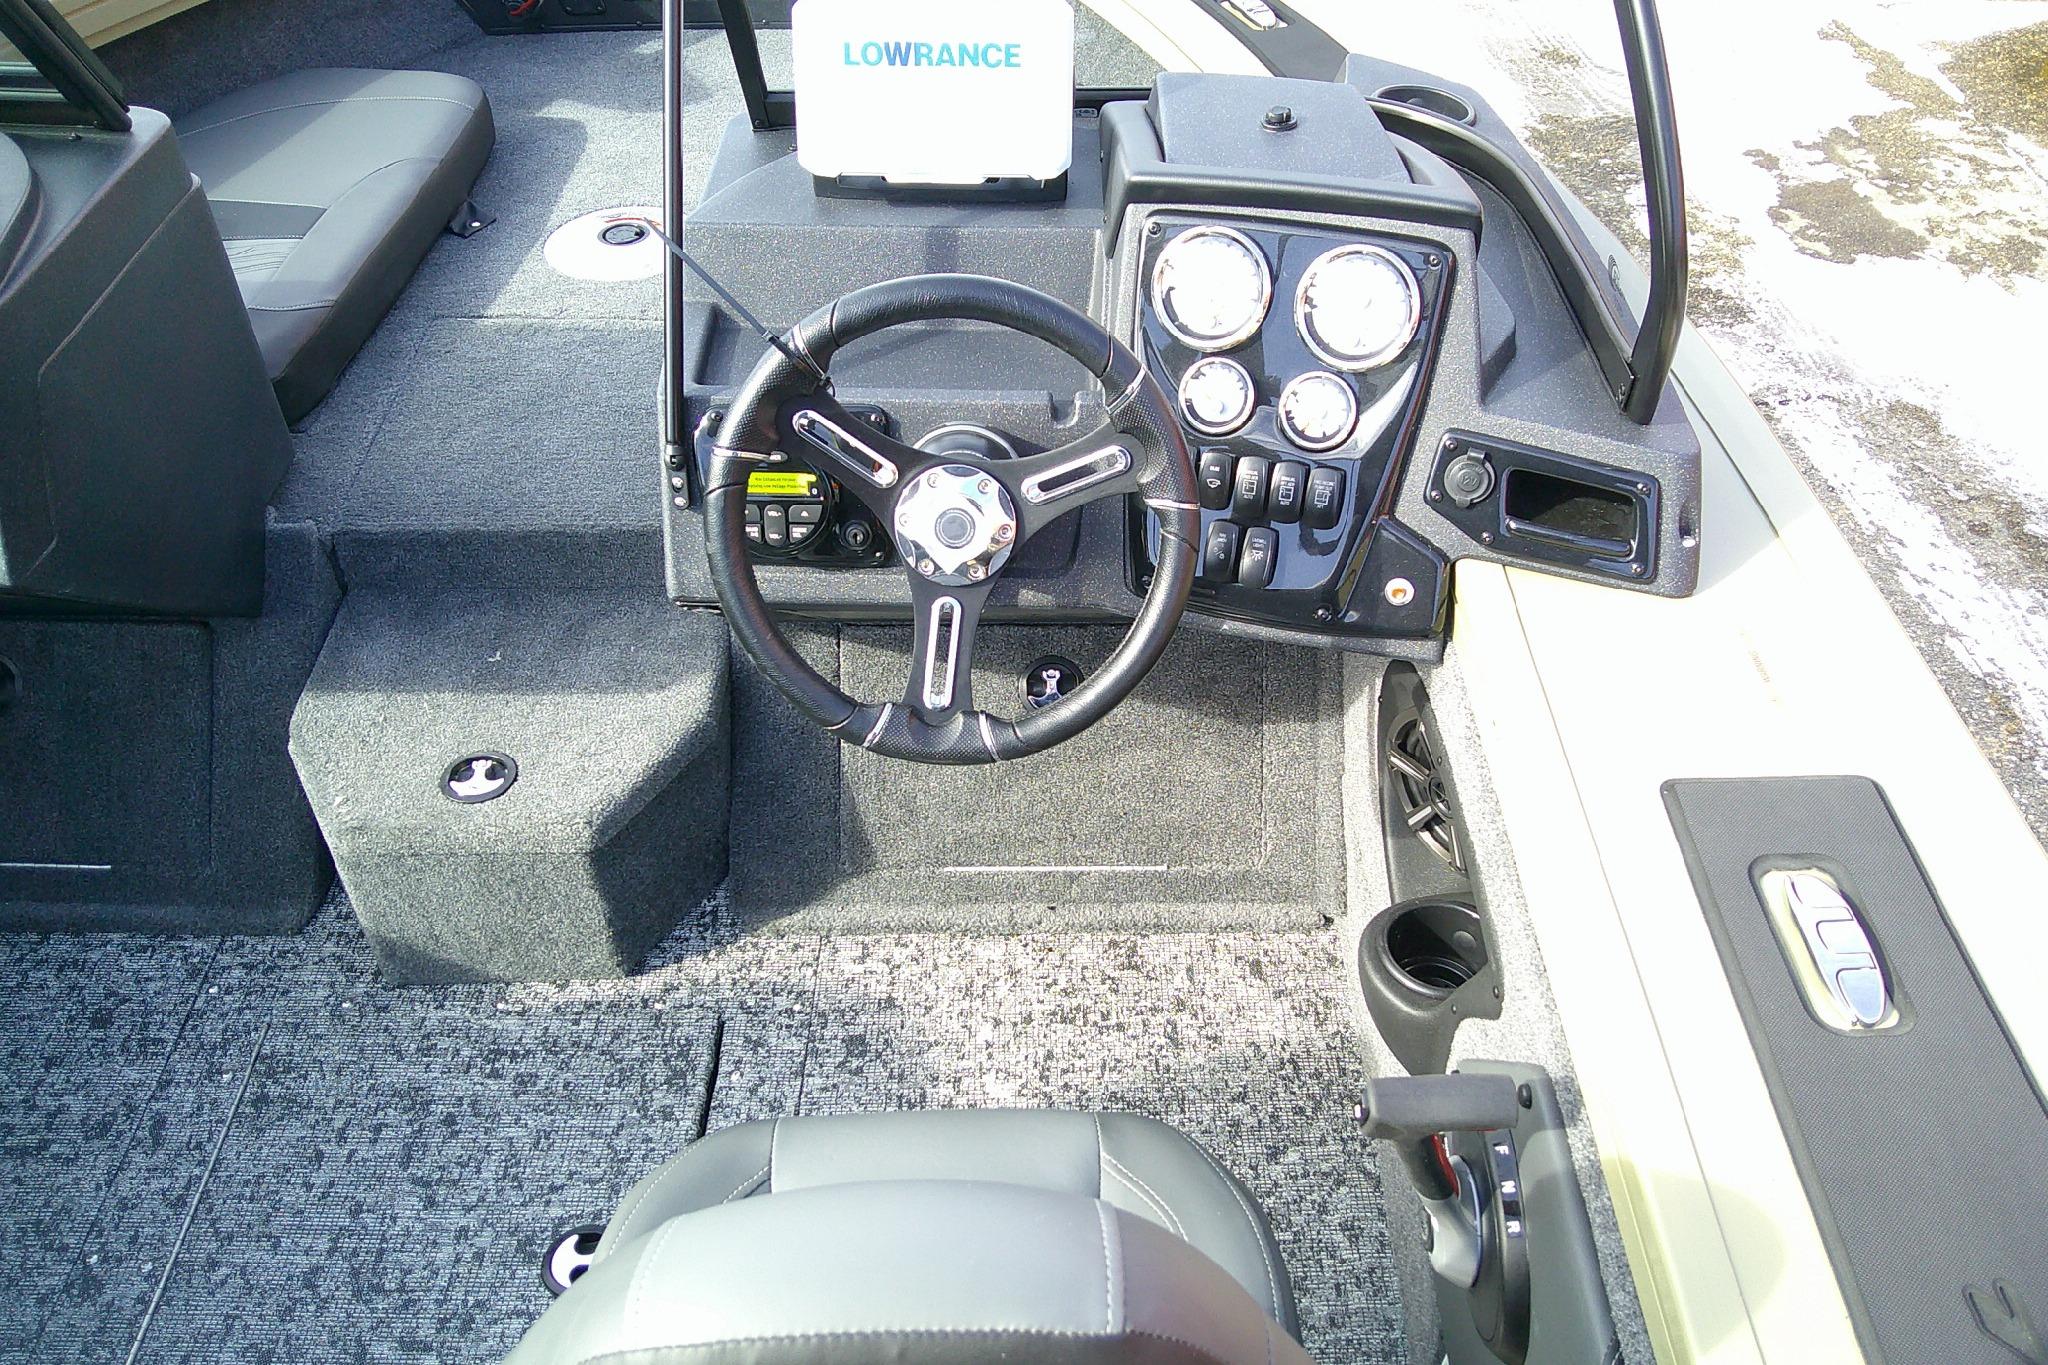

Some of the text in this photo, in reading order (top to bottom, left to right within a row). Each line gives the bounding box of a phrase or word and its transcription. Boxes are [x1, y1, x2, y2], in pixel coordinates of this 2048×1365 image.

[843, 41, 1022, 68] LOWRANCE
[1494, 1145, 1509, 1156] F
[1501, 1180, 1517, 1193] N
[1506, 1220, 1521, 1233] R
